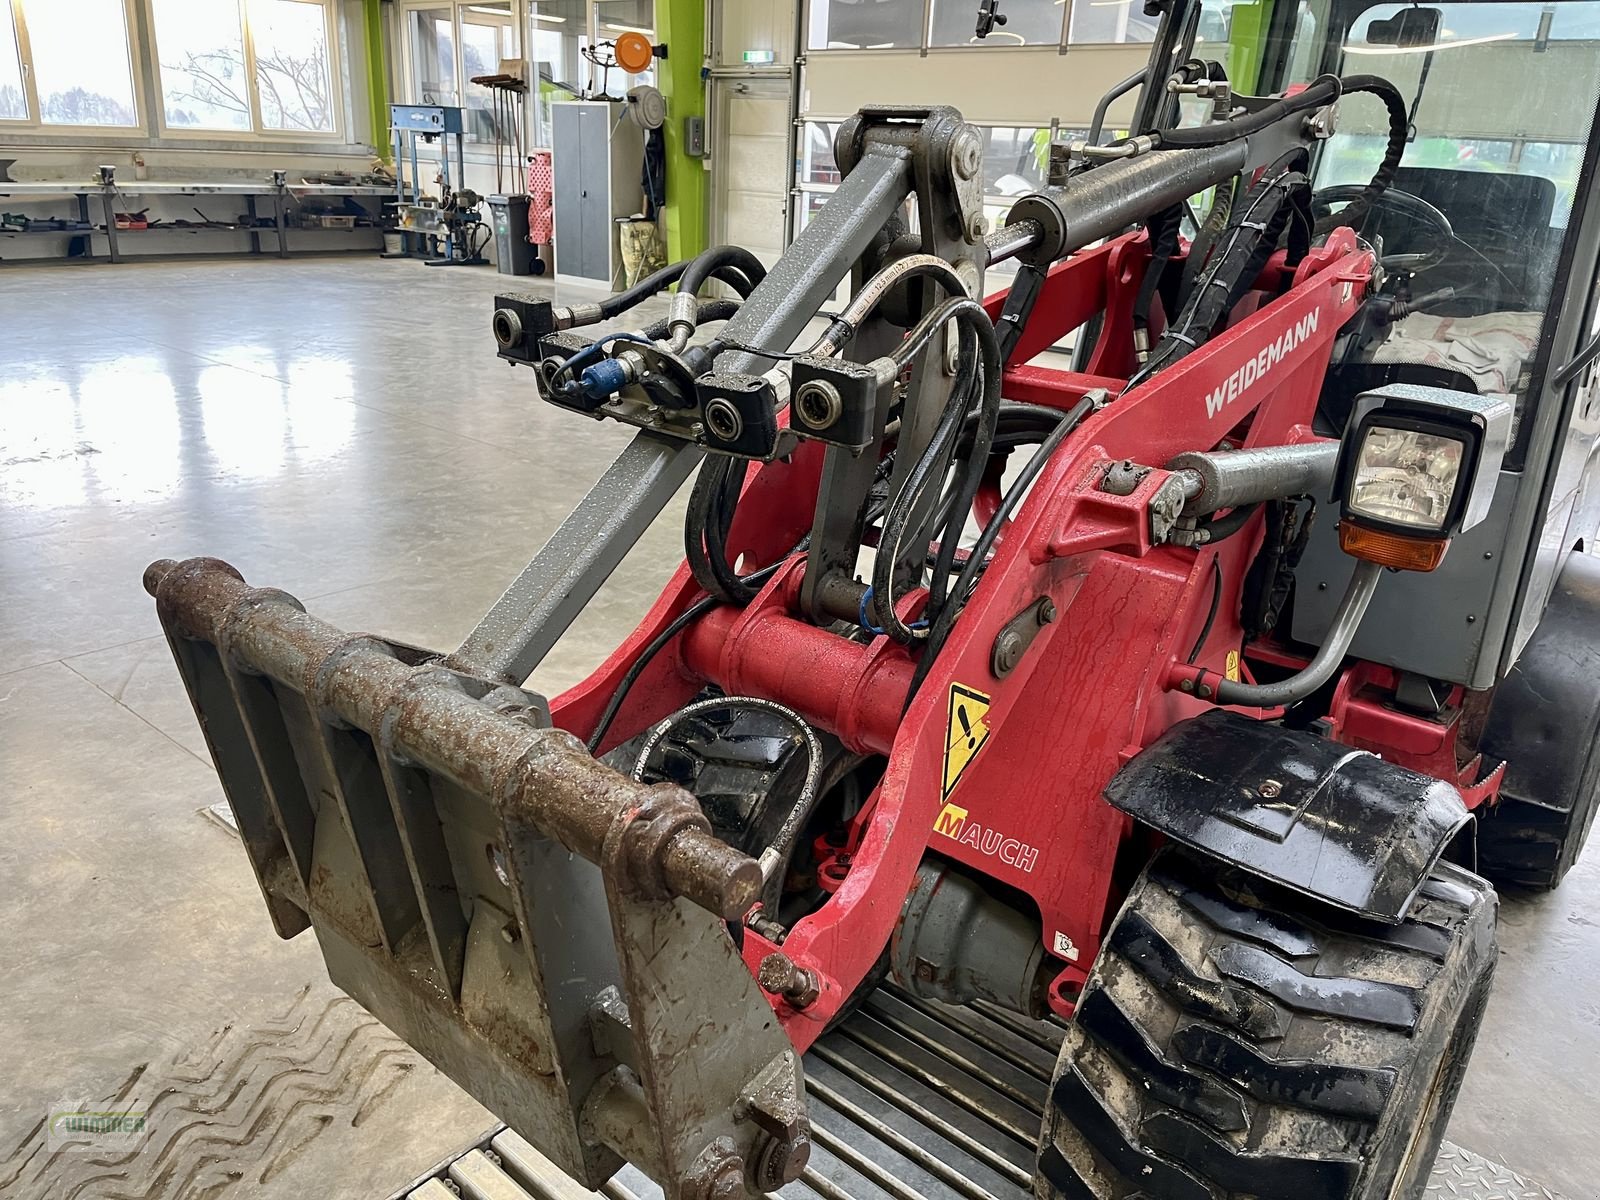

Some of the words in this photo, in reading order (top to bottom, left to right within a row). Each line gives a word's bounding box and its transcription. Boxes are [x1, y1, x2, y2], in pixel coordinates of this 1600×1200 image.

[1205, 306, 1320, 420] WEIDEMANN
[681, 702, 699, 714] ITALY
[702, 697, 721, 707] MADE
[634, 745, 652, 776] COMPACT
[938, 812, 1039, 873] MAUCH
